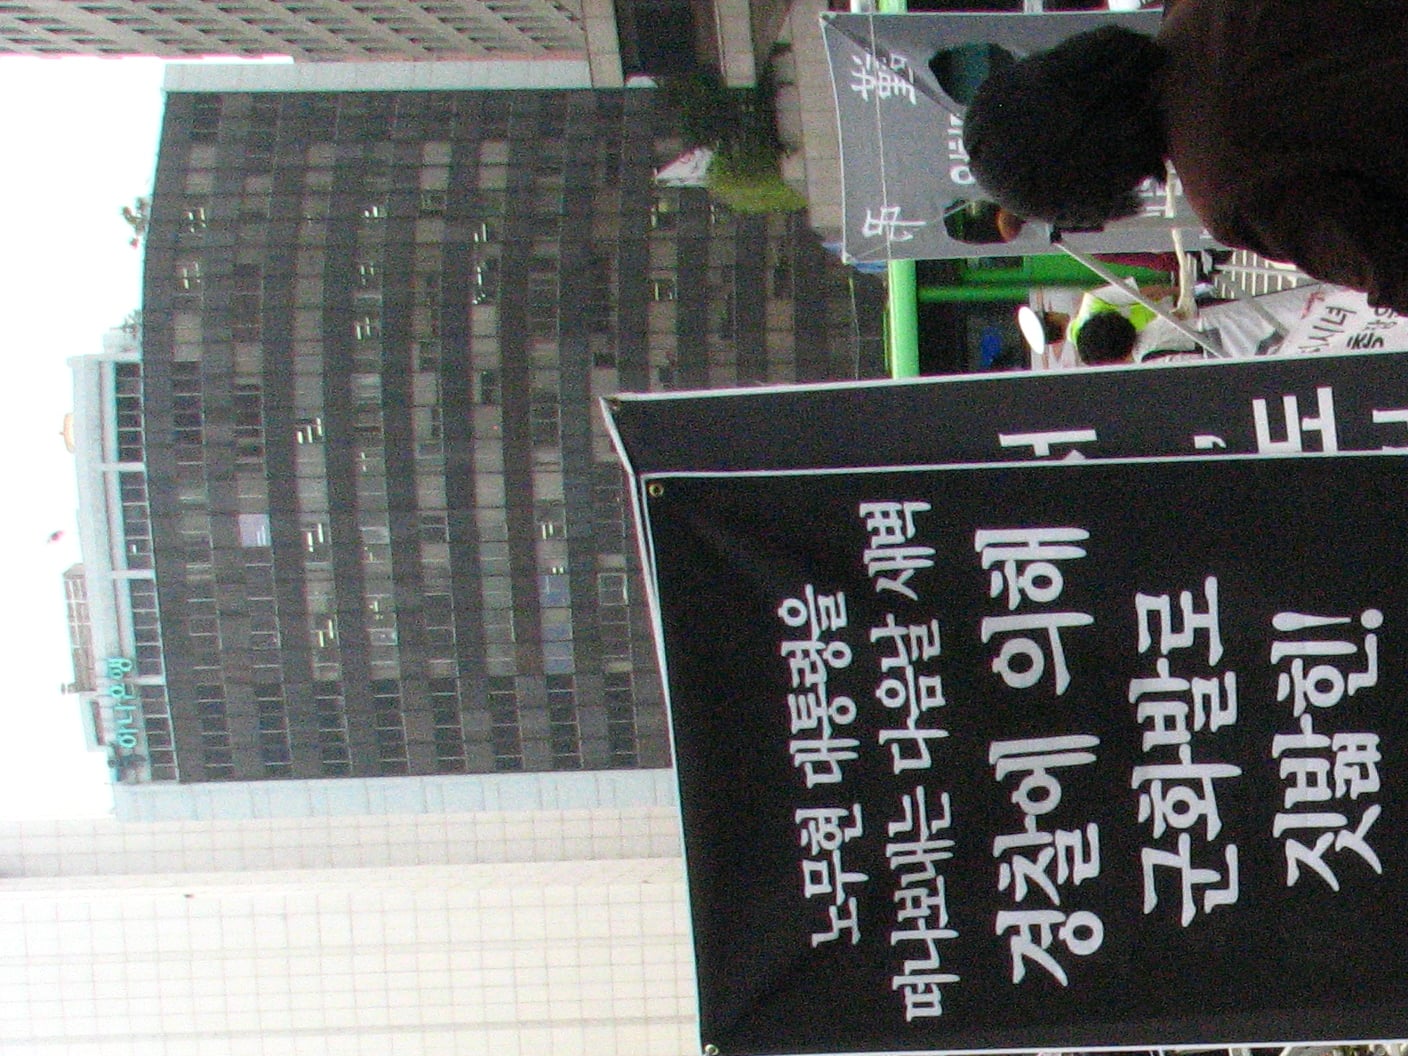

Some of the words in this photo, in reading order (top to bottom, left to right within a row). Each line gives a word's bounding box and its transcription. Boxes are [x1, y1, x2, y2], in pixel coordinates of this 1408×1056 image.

[860, 502, 934, 599] 새벽
[975, 528, 1093, 694] 의해
[778, 585, 858, 787] 대통령을
[871, 615, 948, 773] 다음날
[1129, 577, 1241, 926] 군화발로
[1271, 610, 1382, 890] 짓밟힌!
[796, 804, 867, 946] 노무현
[886, 787, 959, 1021] 떠나보내는
[989, 735, 1103, 985] 경찰에
